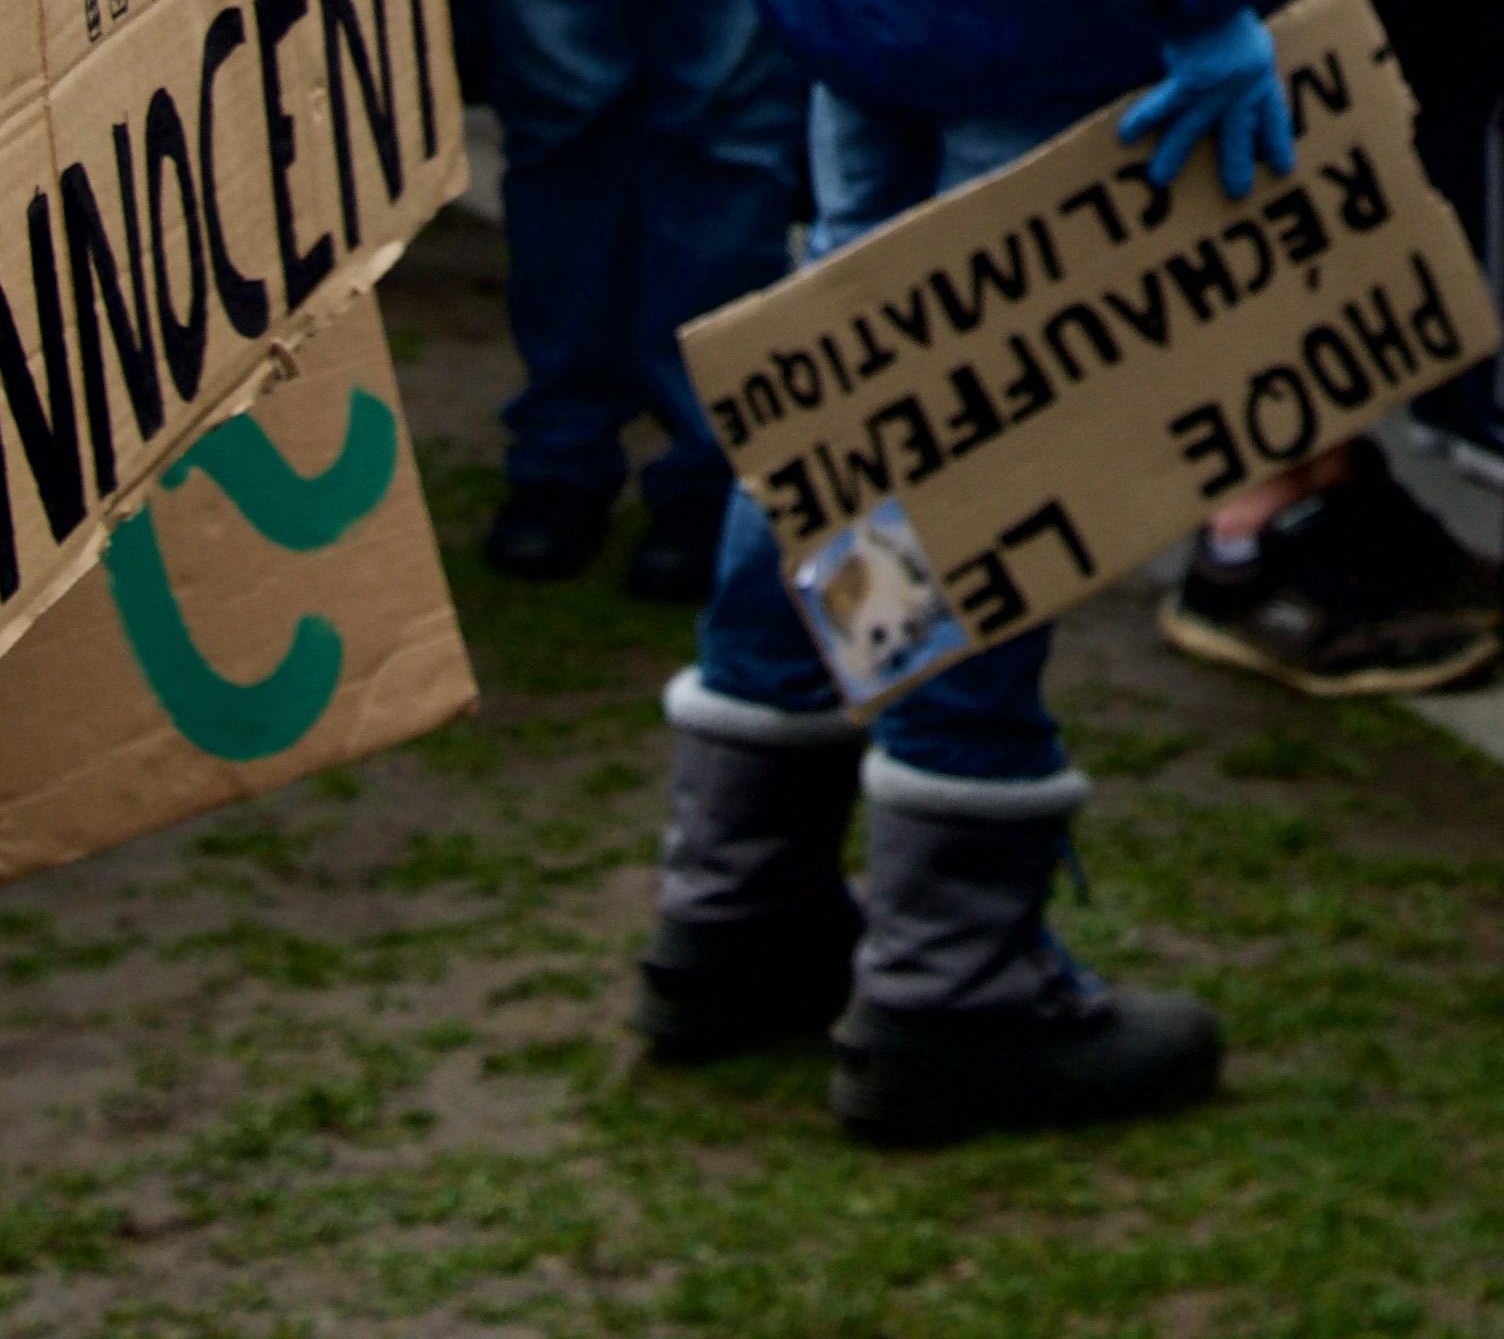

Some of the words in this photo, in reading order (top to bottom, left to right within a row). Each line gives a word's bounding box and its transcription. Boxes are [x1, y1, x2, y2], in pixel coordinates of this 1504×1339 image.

[707, 159, 1177, 450] CLIMATIQUE
[1166, 249, 1465, 501] PHOQE
[943, 497, 1098, 640] LE
